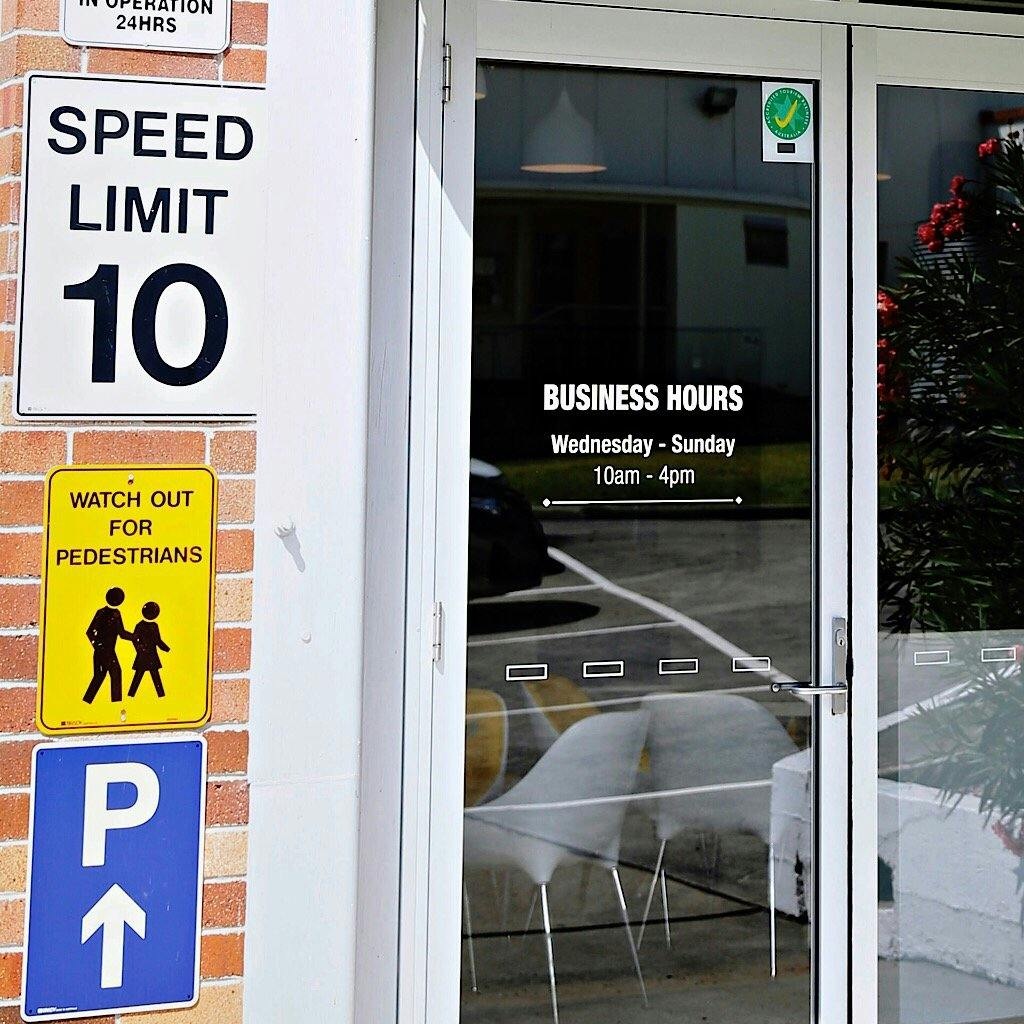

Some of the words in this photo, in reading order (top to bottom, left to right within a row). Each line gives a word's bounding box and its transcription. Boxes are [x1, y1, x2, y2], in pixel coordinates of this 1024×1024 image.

[116, 14, 177, 34] 24HRS
[48, 105, 254, 161] SPEED
[69, 183, 229, 235] LIMIT
[63, 262, 229, 387] 10
[543, 383, 659, 412] BUSINESS
[666, 384, 744, 412] HOURS
[551, 434, 654, 458] Wednesday
[671, 433, 736, 458] Sunday
[593, 465, 640, 485] 10am
[658, 465, 696, 489] 4pm
[70, 491, 141, 509] WATCH
[150, 490, 194, 508] OUT
[109, 519, 153, 537] FOR
[56, 545, 203, 566] PEDESTRIANS
[81, 762, 161, 868] P
